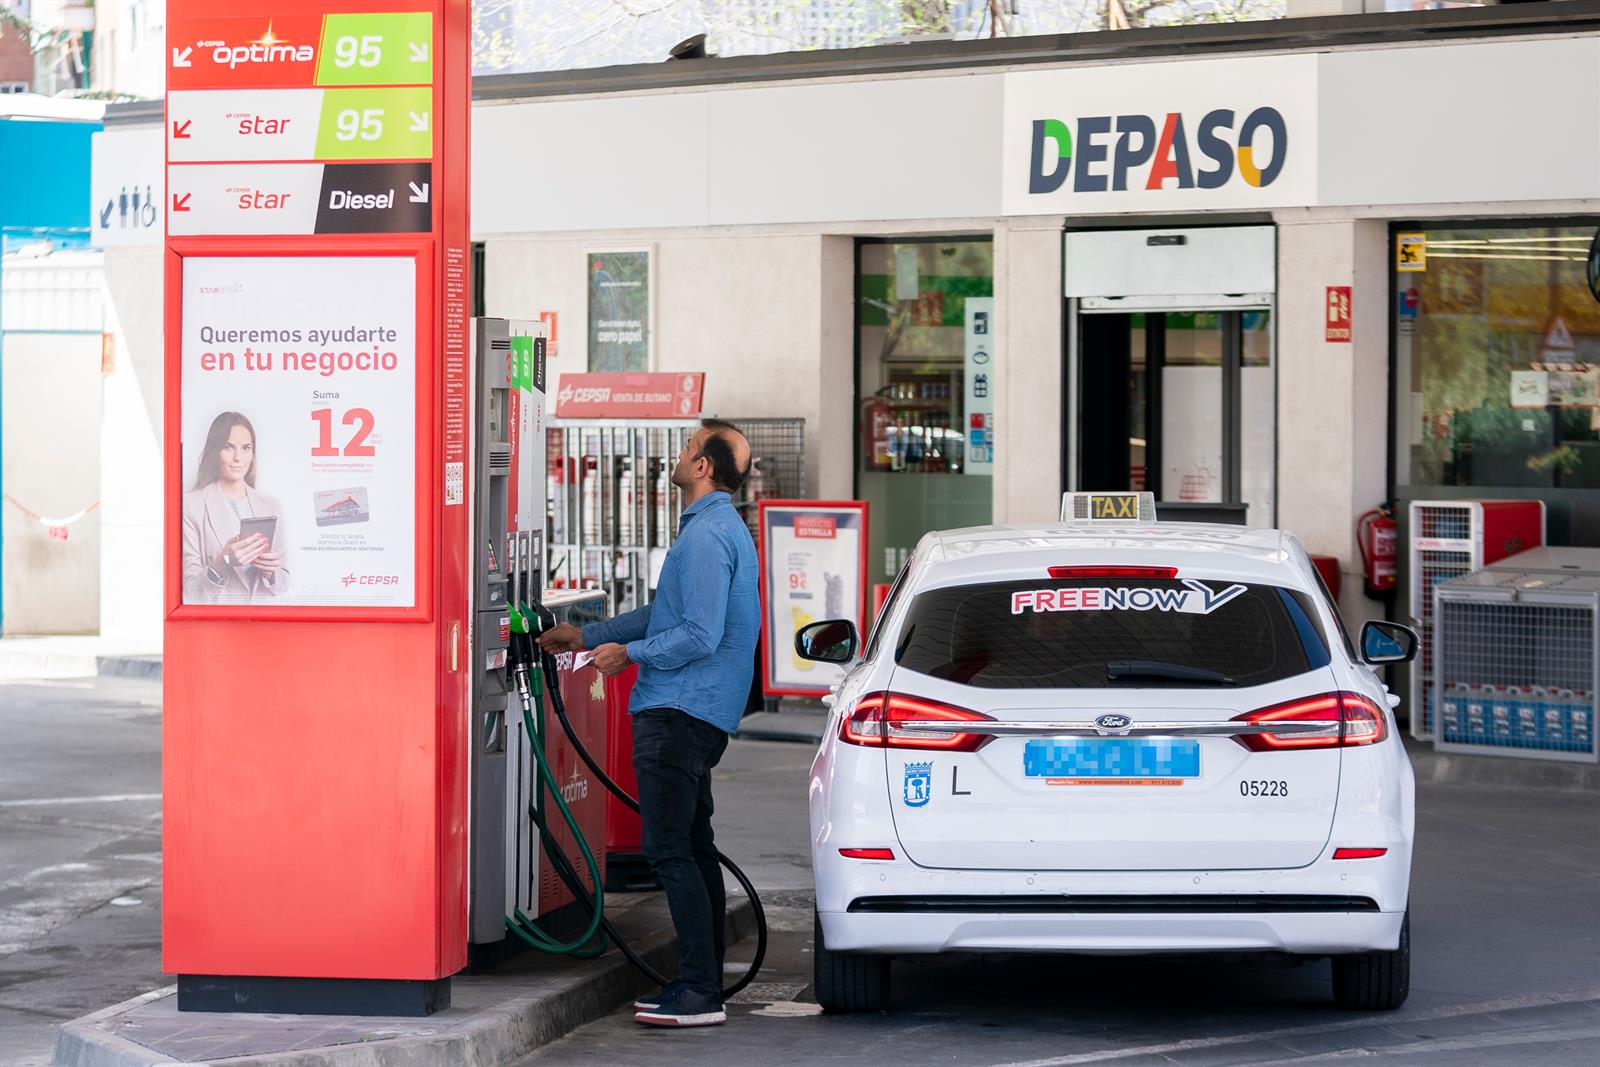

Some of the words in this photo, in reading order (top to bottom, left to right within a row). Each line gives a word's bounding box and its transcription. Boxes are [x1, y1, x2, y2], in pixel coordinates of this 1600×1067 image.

[212, 43, 314, 69] optima
[333, 35, 383, 68] 95
[238, 115, 291, 135] star
[335, 109, 384, 141] 95
[1028, 106, 1288, 194] DEPASO
[238, 190, 291, 209] star
[329, 189, 395, 209] Diesel
[200, 326, 303, 345] Queremos
[307, 326, 398, 346] ayudarte
[200, 351, 235, 371] en
[243, 348, 273, 371] tu
[282, 346, 399, 377] negocio
[312, 390, 340, 399] Suma
[574, 388, 611, 403] CEPSA
[311, 407, 376, 457] 12
[1091, 496, 1137, 518] TAXI
[799, 528, 833, 537] ESTRELLA
[359, 575, 399, 585] CEPSA
[1014, 589, 1189, 612] FREENOW
[1102, 716, 1125, 726] Ford
[952, 766, 971, 795] L
[1239, 780, 1289, 797] 05228
